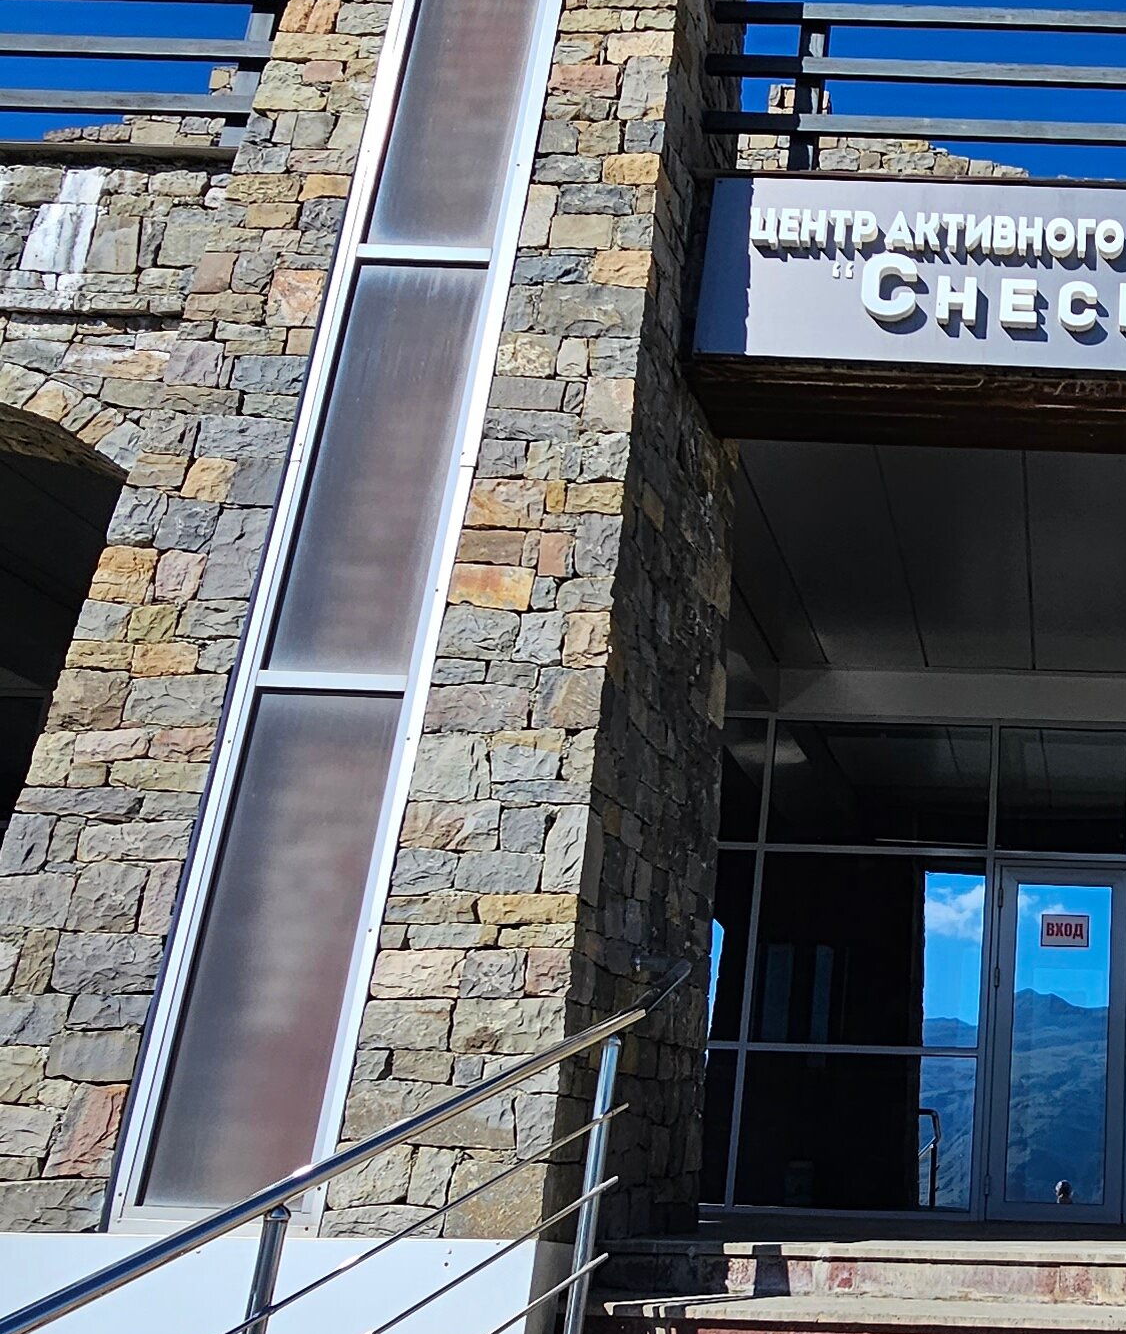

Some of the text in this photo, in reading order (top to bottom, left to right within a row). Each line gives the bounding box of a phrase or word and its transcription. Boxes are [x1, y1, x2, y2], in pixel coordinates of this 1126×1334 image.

[751, 207, 878, 250] ЦЕНТР
[884, 210, 1125, 259] АКТИВНОГО
[1046, 922, 1084, 940] ВХОД
